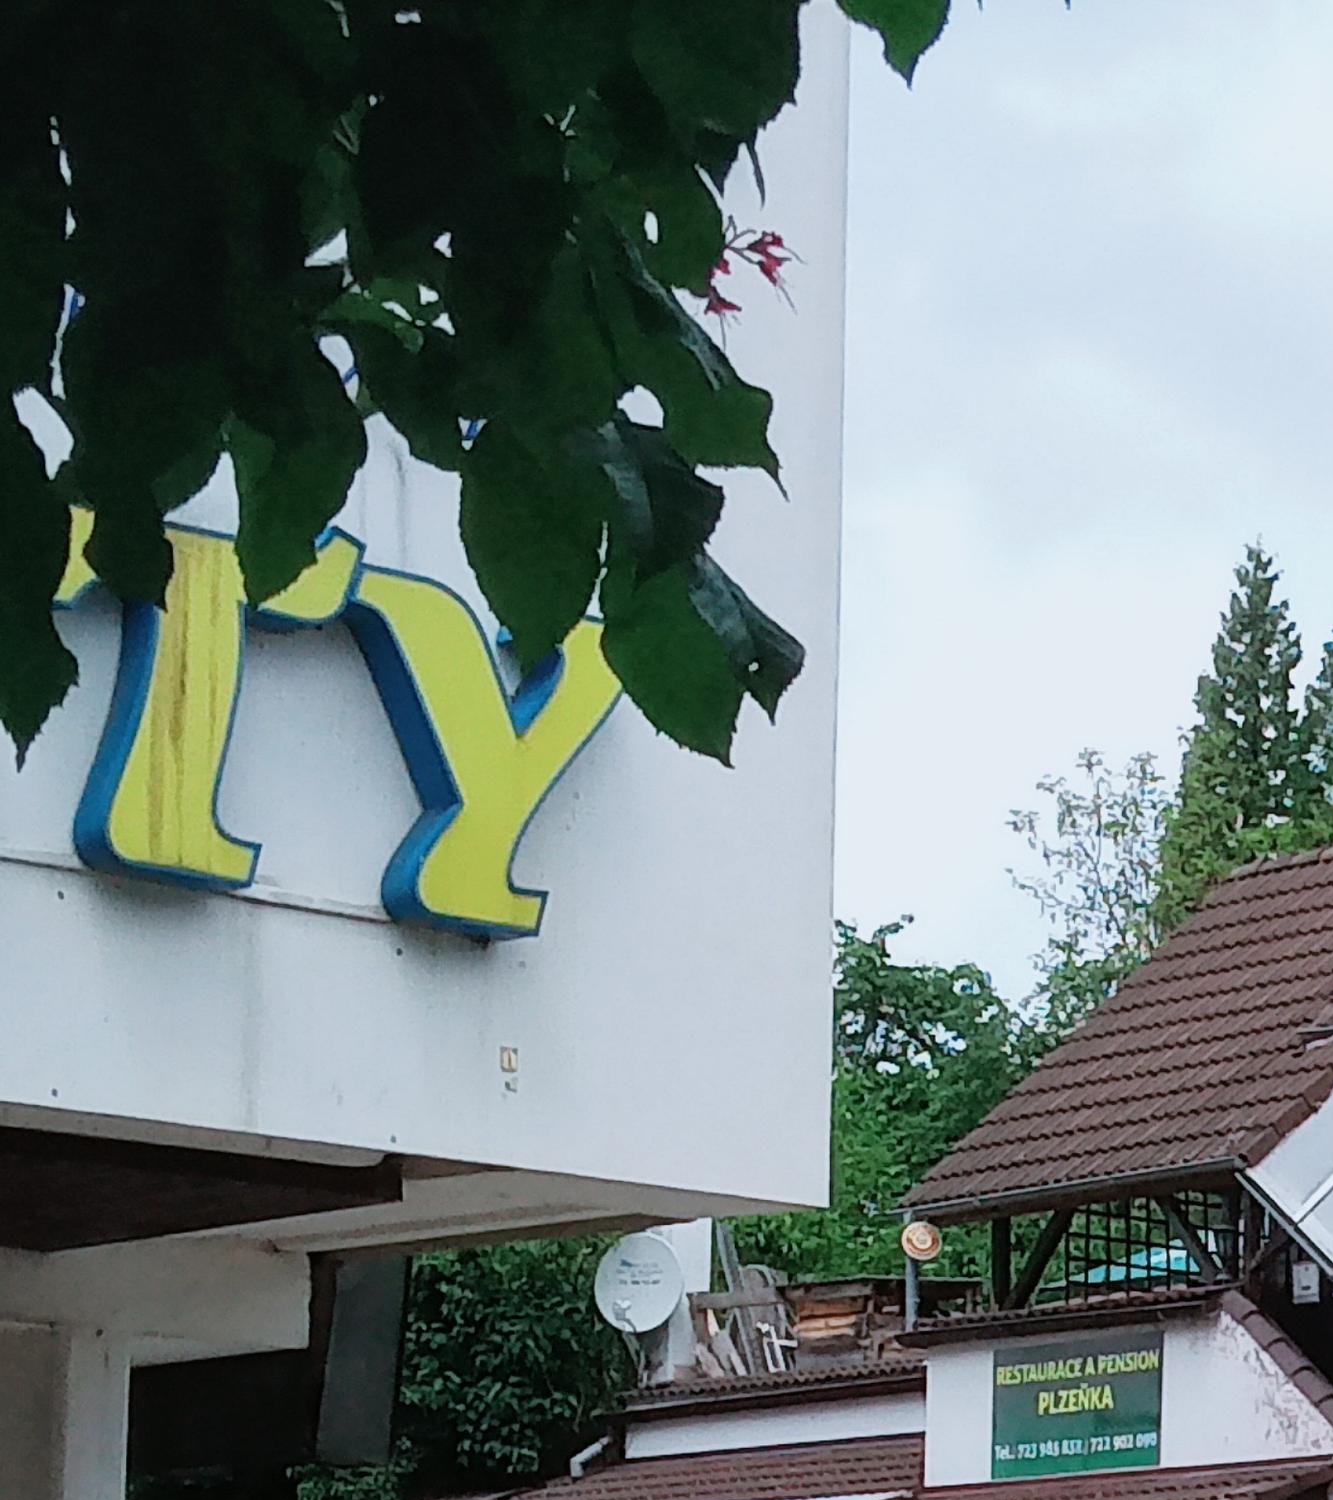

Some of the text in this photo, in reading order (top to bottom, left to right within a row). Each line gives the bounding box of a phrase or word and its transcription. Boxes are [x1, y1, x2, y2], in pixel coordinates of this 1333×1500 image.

[996, 1348, 1160, 1386] RESTAURACE A PENSION
[1037, 1382, 1114, 1416] PLZEŇKA
